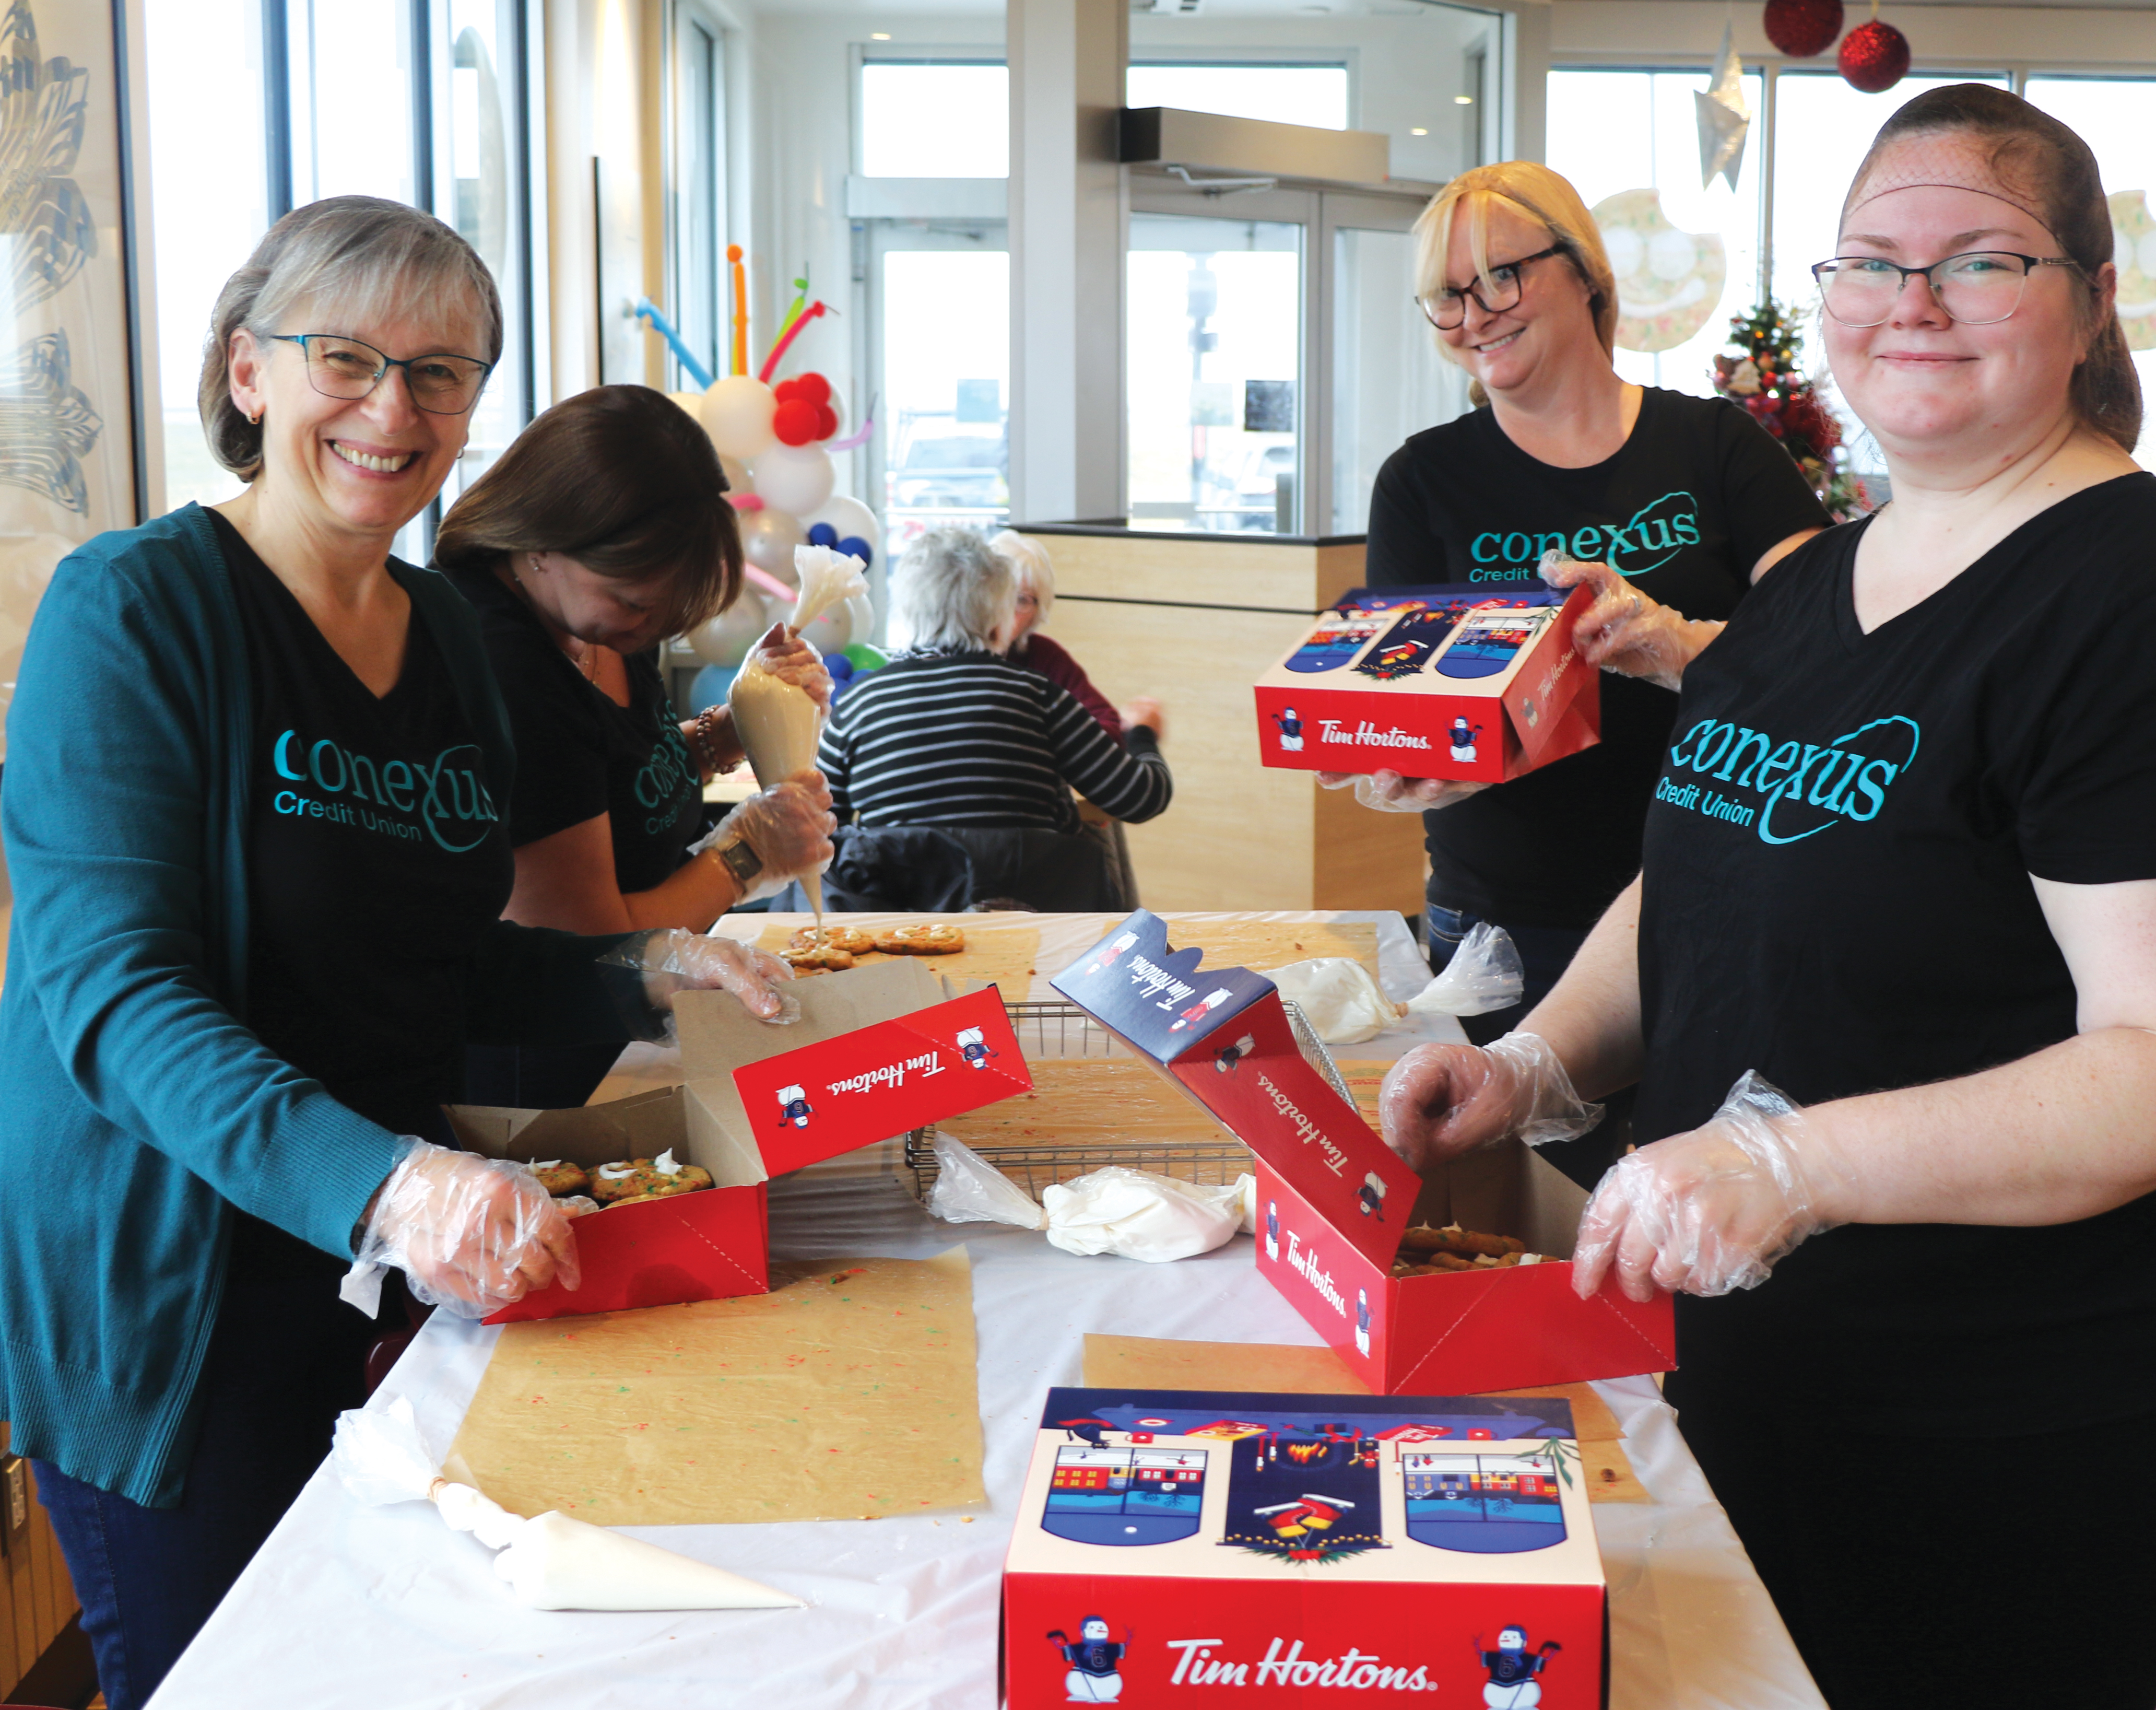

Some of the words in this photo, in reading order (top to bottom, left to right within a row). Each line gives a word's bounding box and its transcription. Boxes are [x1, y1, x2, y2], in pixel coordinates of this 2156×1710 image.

[1470, 491, 1701, 576] conexus
[1469, 567, 1530, 583] Credit
[1537, 679, 1553, 701] Tim
[1318, 719, 1354, 745] Tim
[1355, 720, 1428, 749] Hortons
[1655, 776, 1701, 811] Credit
[1701, 790, 1755, 827] Union
[1670, 715, 1920, 845] conexus
[273, 790, 356, 826] Credit
[360, 809, 422, 841] Union
[1156, 980, 1196, 1011] Tim
[832, 1061, 906, 1096] Hortons
[906, 1051, 946, 1077] Tim
[1258, 1075, 1320, 1144] Hortons
[1319, 1134, 1349, 1177] Tim
[1287, 1229, 1305, 1275] Tim
[1305, 1248, 1345, 1316] Hortons
[1167, 1638, 1248, 1686] Tim
[1255, 1637, 1429, 1691] Hortons
